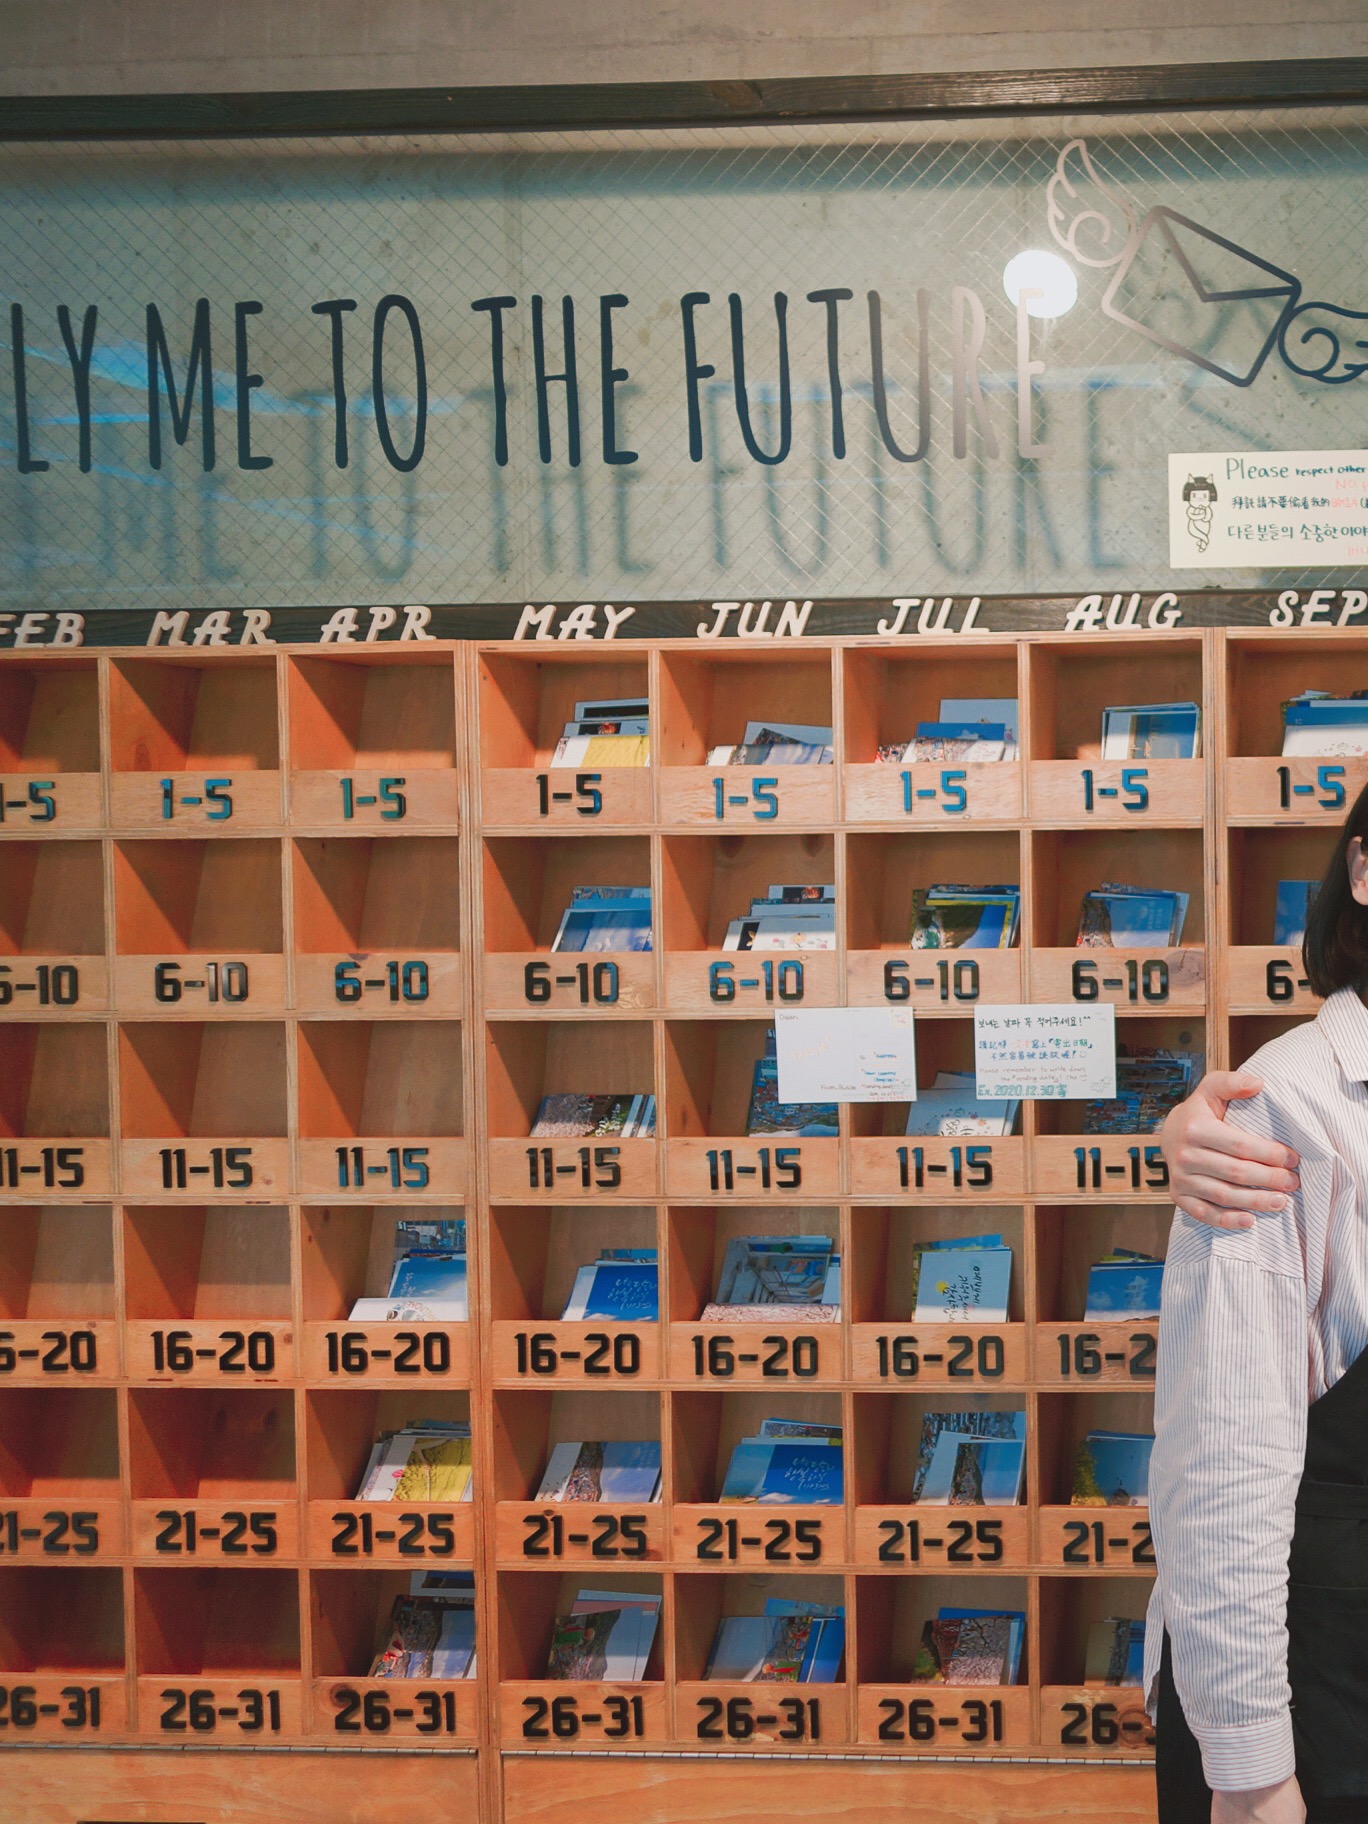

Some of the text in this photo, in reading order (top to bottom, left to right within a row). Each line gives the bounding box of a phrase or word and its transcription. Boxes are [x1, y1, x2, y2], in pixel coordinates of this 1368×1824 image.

[147, 296, 273, 473] ME
[312, 294, 428, 473] TO
[470, 294, 639, 469] THE
[680, 287, 1056, 465] FUTURE
[1226, 458, 1289, 480] Please
[1295, 466, 1333, 477] respect
[1337, 465, 1365, 473] other
[147, 610, 277, 646] MAR
[320, 606, 436, 643] APR
[514, 604, 636, 640] MAY
[697, 600, 813, 637] JUN
[877, 597, 990, 636] JUL
[1064, 593, 1183, 632] AUG
[160, 778, 233, 820] 1-5
[339, 777, 406, 819] 1-5
[534, 773, 603, 815] 1-5
[713, 778, 779, 819] 1-5
[899, 770, 967, 813] 1-5
[1081, 768, 1149, 810] 1-5
[1276, 765, 1346, 808] 1-5
[154, 962, 249, 1002] 6-10
[335, 960, 429, 1000] 6-10
[524, 961, 620, 1003] 6-10
[708, 961, 804, 1002] 6-10
[883, 960, 979, 1000] 6-10
[1072, 959, 1169, 1001] 6-10
[159, 1147, 253, 1188] 11-15
[336, 1146, 429, 1188] 11-15
[525, 1146, 621, 1188] 11-15
[706, 1148, 801, 1190] 11-15
[896, 1146, 994, 1187] 11-15
[1073, 1146, 1170, 1187] 11-15
[151, 1330, 276, 1372] 16-20
[325, 1331, 451, 1372] 16-20
[514, 1332, 641, 1374] 16-20
[691, 1335, 820, 1377] 16-20
[876, 1335, 1004, 1377] 16-20
[1057, 1334, 1156, 1376] 16-2
[155, 1510, 277, 1554] 21-25
[331, 1512, 454, 1555] 21-25
[522, 1514, 647, 1557] 21-25
[696, 1519, 822, 1562] 21-25
[878, 1520, 1004, 1562] 21-25
[1062, 1521, 1155, 1563] 21-2
[160, 1689, 281, 1731] 26-31
[334, 1690, 456, 1732] 26-31
[522, 1696, 645, 1738] 26-31
[696, 1697, 821, 1740] 26-31
[878, 1698, 1003, 1742] 26-31
